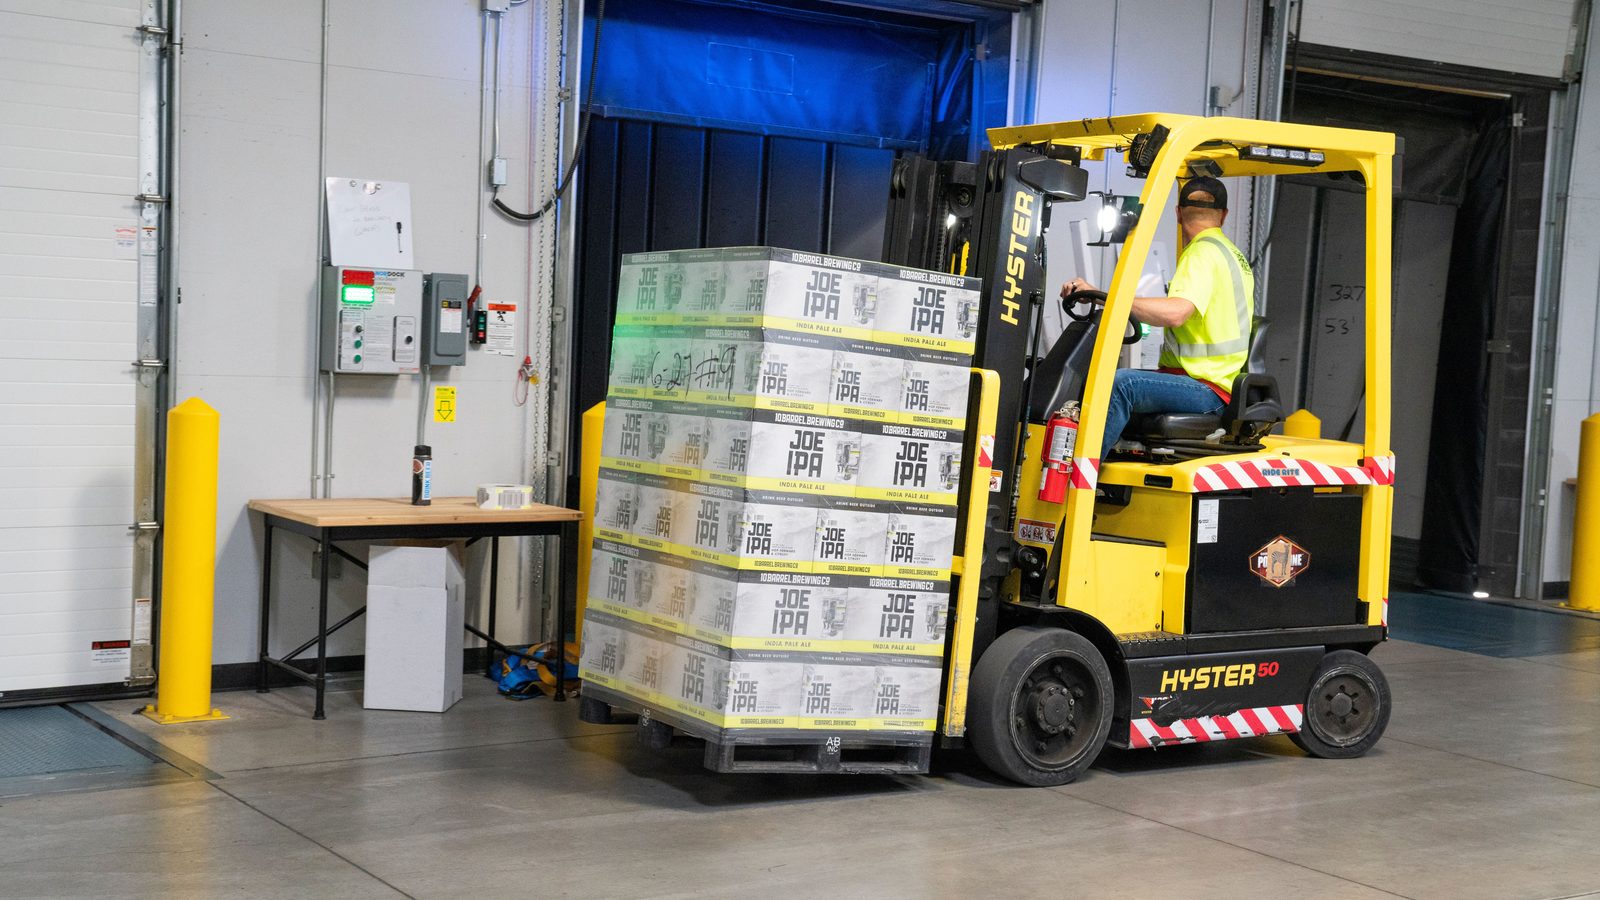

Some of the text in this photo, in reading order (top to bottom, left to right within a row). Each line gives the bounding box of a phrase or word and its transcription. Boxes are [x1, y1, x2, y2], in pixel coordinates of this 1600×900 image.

[1000, 191, 1033, 325] HYSTER
[639, 268, 658, 285] JOE
[748, 279, 764, 292] JOE
[806, 270, 841, 293] JOE
[703, 280, 718, 292] JOE
[1329, 284, 1366, 301] 327
[636, 287, 657, 309] IPA
[701, 293, 717, 310] IPA
[746, 294, 762, 311] IPA
[802, 290, 840, 319] IPA
[913, 286, 946, 308] JOE
[796, 321, 814, 329] INDIA
[910, 306, 944, 334] IPA
[631, 368, 645, 384] IPA
[763, 361, 788, 377] JOE
[837, 369, 861, 385] JOE
[761, 375, 786, 395] IPA
[835, 383, 859, 403] IPA
[906, 378, 929, 394] JOE
[904, 392, 928, 411] IPA
[623, 413, 642, 432] JOE
[620, 432, 641, 456] IPA
[686, 433, 700, 446] JOE
[731, 439, 747, 453] JOE
[789, 429, 825, 451] JOE
[684, 447, 699, 464] IPA
[895, 440, 929, 462] JOE
[729, 453, 746, 471] IPA
[786, 450, 822, 478] IPA
[893, 461, 926, 487] IPA
[1262, 468, 1299, 476] RIDE RITE
[617, 499, 630, 512] JOE
[657, 506, 671, 520] JOE
[698, 500, 720, 521] JOE
[616, 512, 629, 529] IPA
[655, 520, 670, 537] IPA
[747, 522, 772, 537] JOE
[695, 520, 718, 547] IPA
[821, 527, 845, 542] JOE
[892, 531, 915, 546] JOE
[745, 536, 771, 555] IPA
[819, 541, 844, 559] IPA
[890, 545, 913, 563] IPA
[609, 557, 628, 577] JOE
[607, 576, 627, 602] IPA
[672, 586, 686, 600] JOE
[717, 597, 732, 613] JOE
[774, 588, 811, 609] JOE
[882, 593, 916, 613] JOE
[670, 600, 685, 618] IPA
[714, 612, 730, 632] IPA
[772, 609, 808, 635] IPA
[879, 614, 913, 638] IPA
[603, 643, 616, 658] JOE
[601, 656, 615, 674] IPA
[643, 656, 657, 671] JOE
[684, 653, 706, 678] JOE
[642, 670, 656, 688] IPA
[1160, 662, 1279, 692] HYSTER 50
[681, 673, 704, 703] IPA
[734, 680, 758, 694] JOE
[807, 682, 831, 696] JOE
[877, 684, 900, 697] JOE
[732, 694, 756, 712] IPA
[805, 696, 830, 714] IPA
[875, 697, 899, 714] IPA
[826, 737, 840, 746] AB
